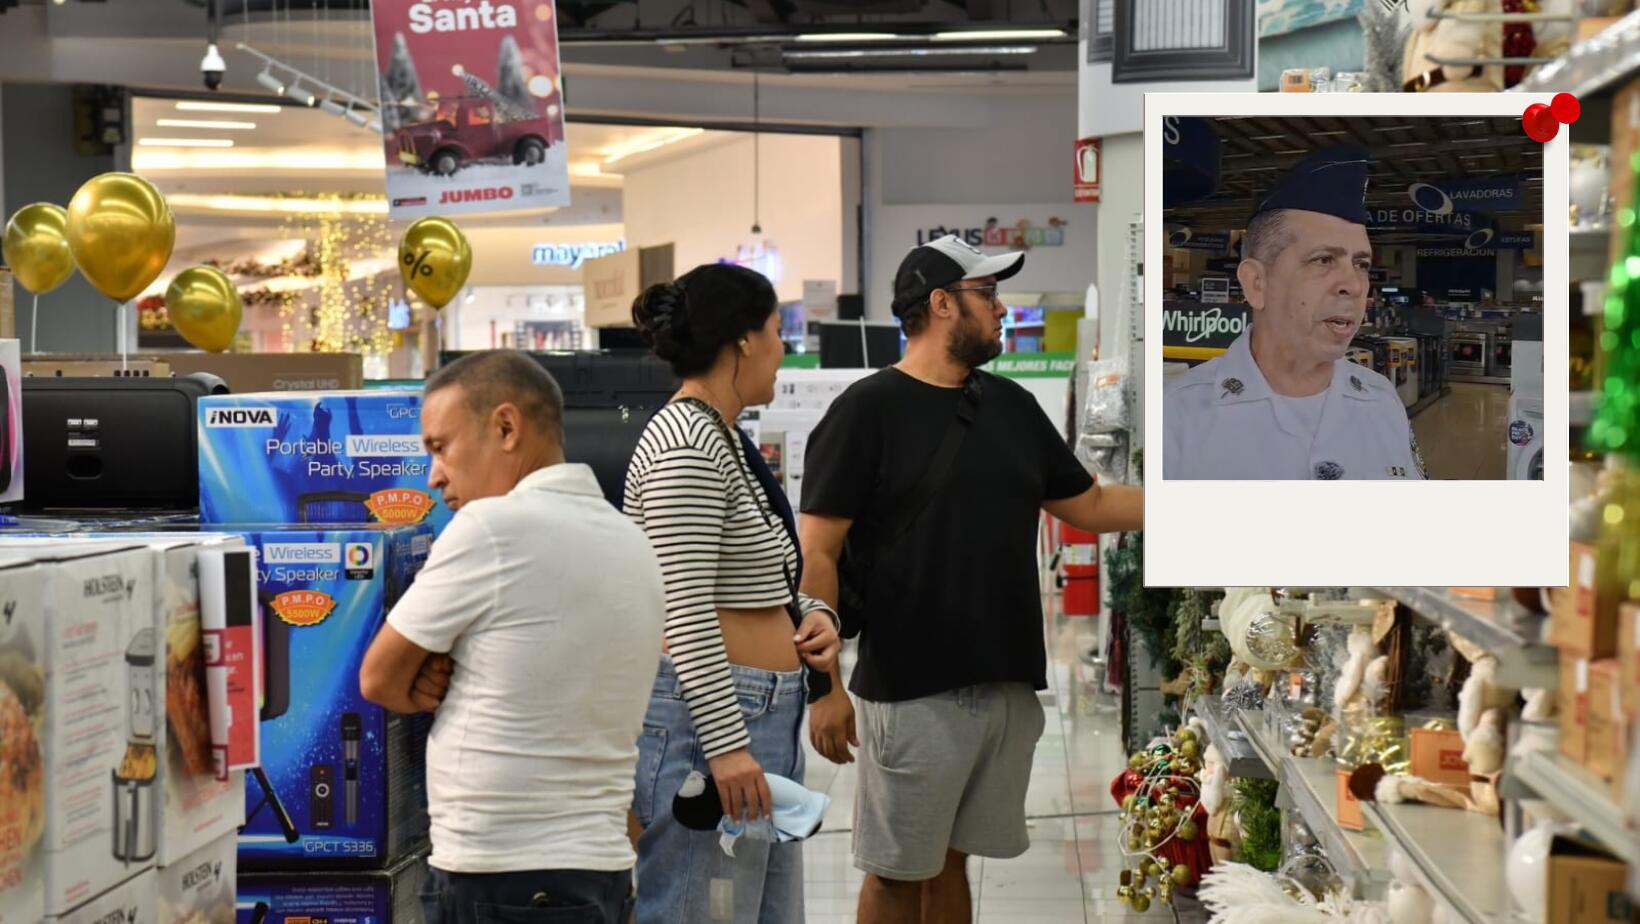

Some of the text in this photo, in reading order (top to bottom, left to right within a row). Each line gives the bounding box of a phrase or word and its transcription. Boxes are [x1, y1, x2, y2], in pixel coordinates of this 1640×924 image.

[408, 0, 518, 34] Santa
[439, 186, 514, 205] JUMBO
[1450, 188, 1514, 200] LAVADORAS
[1377, 209, 1399, 223] DE
[1402, 208, 1472, 227] OFERTAS
[1162, 309, 1248, 339] Whirlpool
[273, 379, 315, 391] Crystal
[266, 438, 420, 455] Portable Wireless
[308, 461, 427, 480] Party Speaker
[269, 545, 333, 560] Wireless
[275, 567, 339, 584] Speaker
[305, 840, 374, 853] GPCT S336
